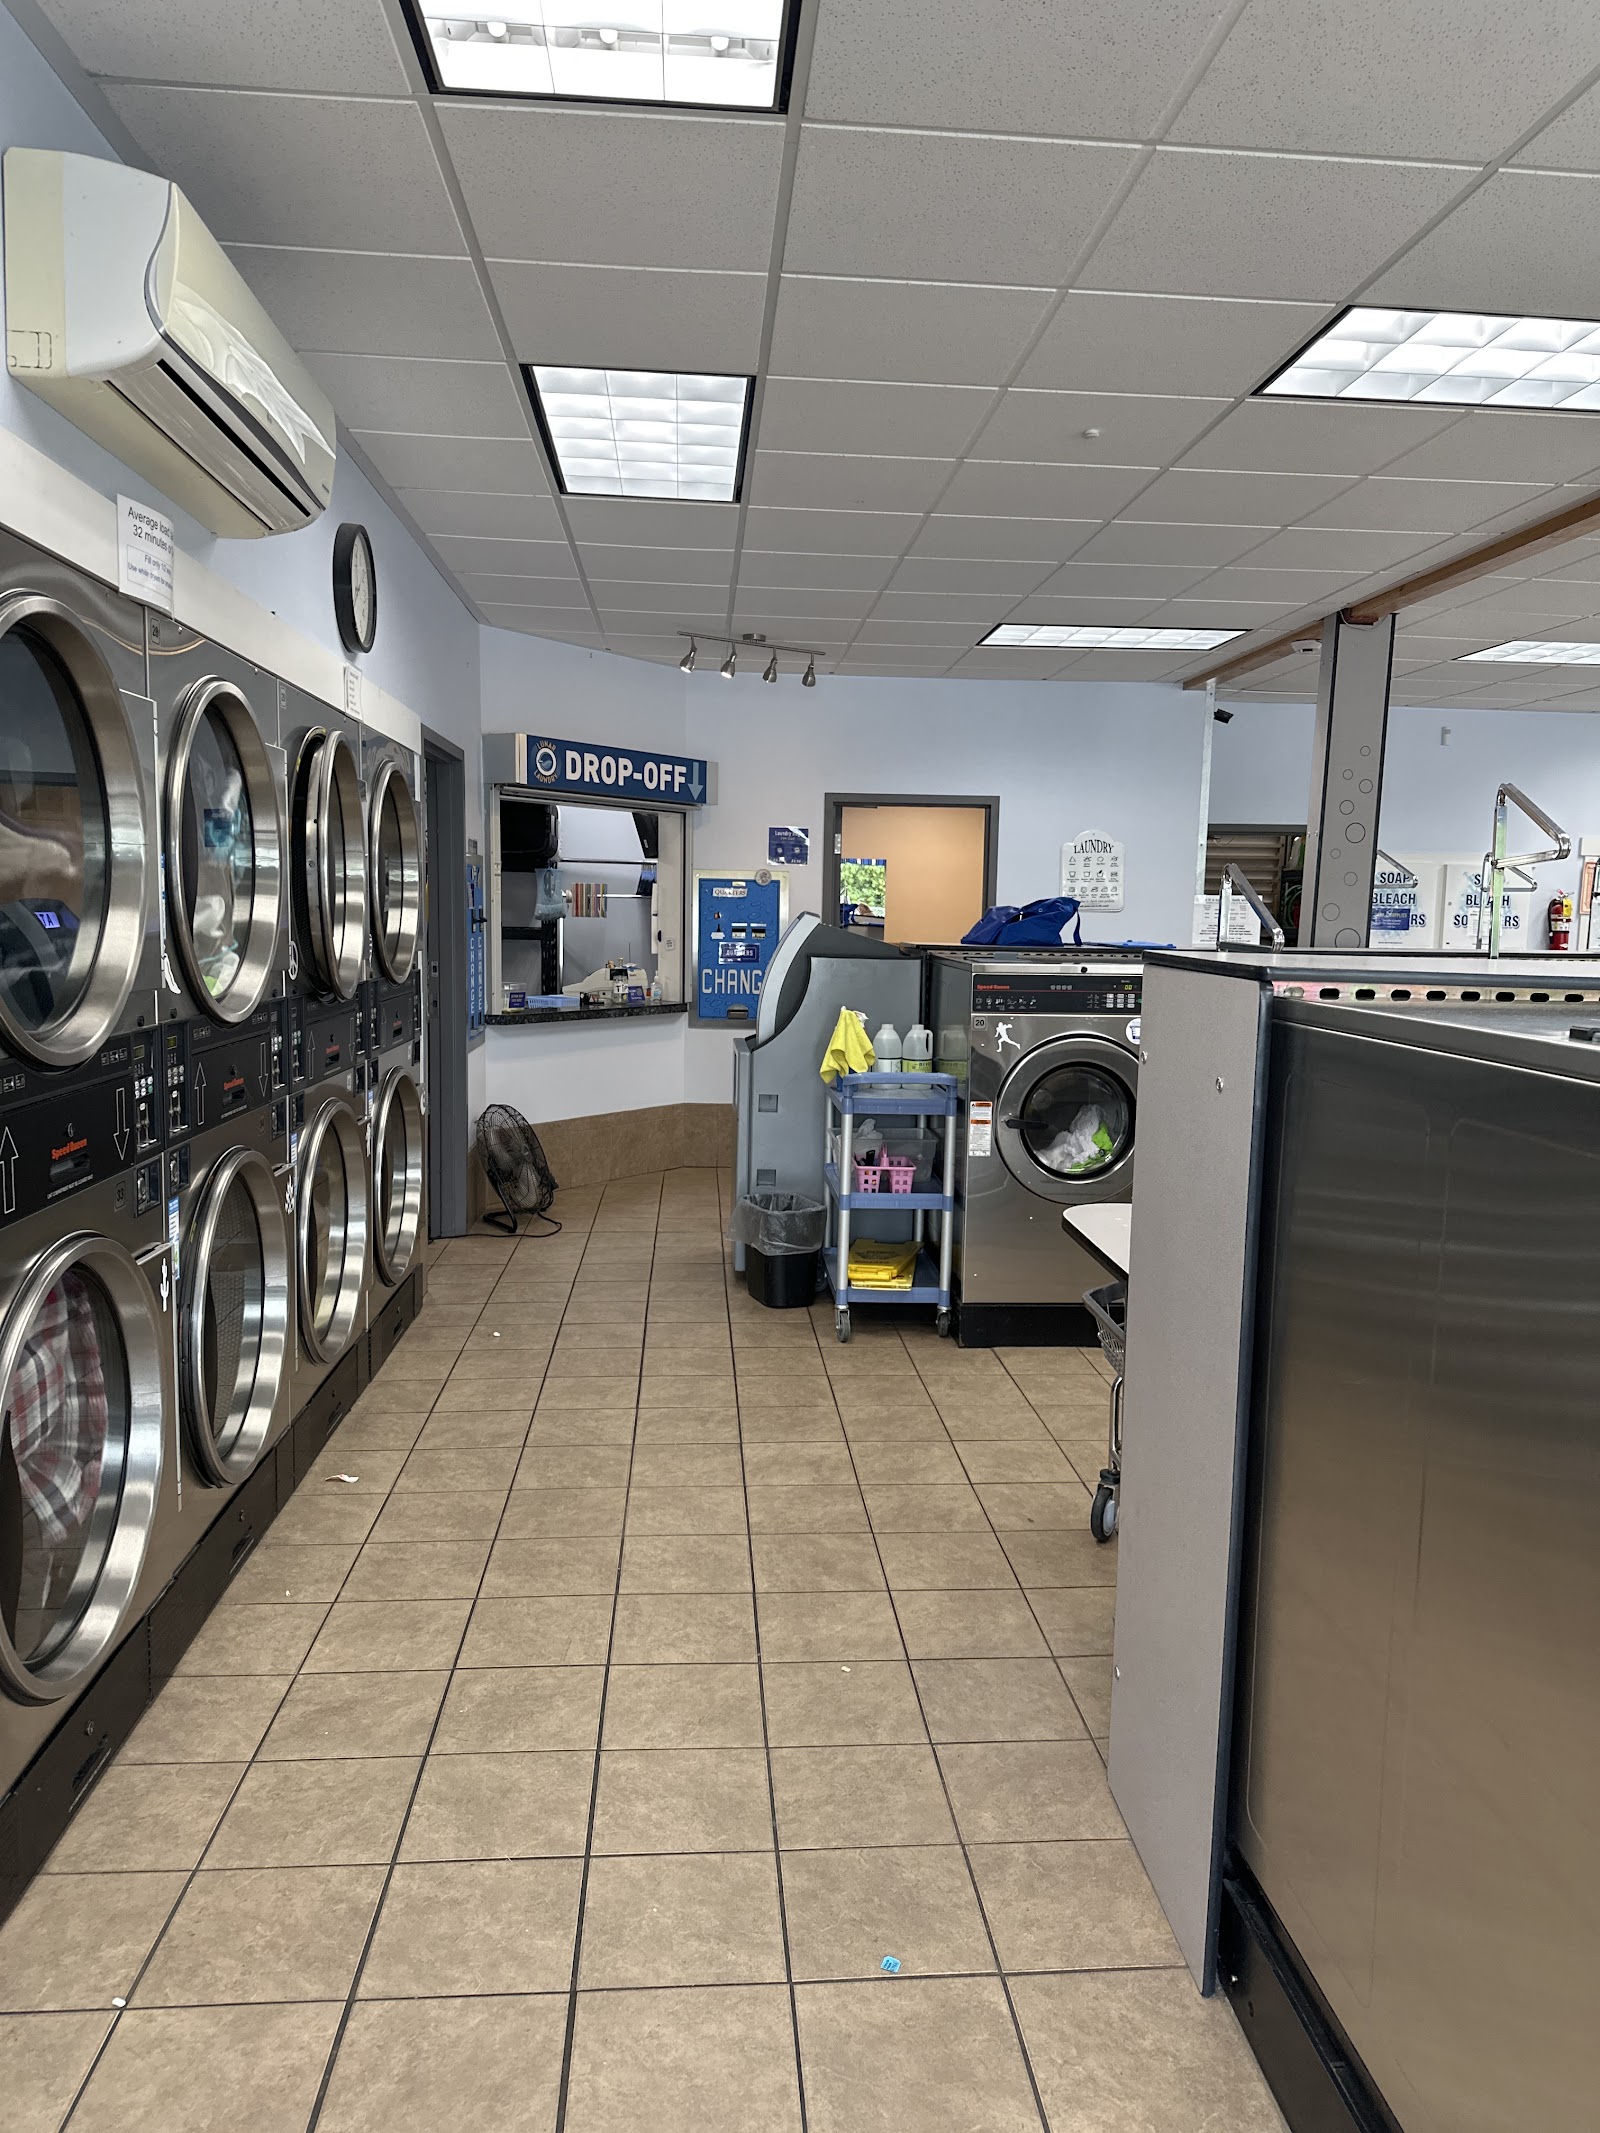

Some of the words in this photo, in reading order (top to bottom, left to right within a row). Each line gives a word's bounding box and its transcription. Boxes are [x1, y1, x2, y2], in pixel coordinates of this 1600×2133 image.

[127, 506, 158, 531] Average
[132, 524, 143, 539] 32
[144, 532, 168, 552] minutes
[536, 740, 557, 752] LUNAR
[534, 769, 559, 784] LAUNDRY
[565, 750, 687, 793] DROP-OFF
[1073, 839, 1114, 854] LAUNDRY
[1379, 871, 1410, 884] SOAP
[714, 888, 746, 897] QUTERS
[1372, 892, 1416, 905] BLEACH
[1465, 894, 1510, 907] BLAH
[701, 968, 765, 995] CHANG
[975, 1019, 985, 1027] 20
[52, 1142, 70, 1160] Speed
[70, 1139, 87, 1151] Queen
